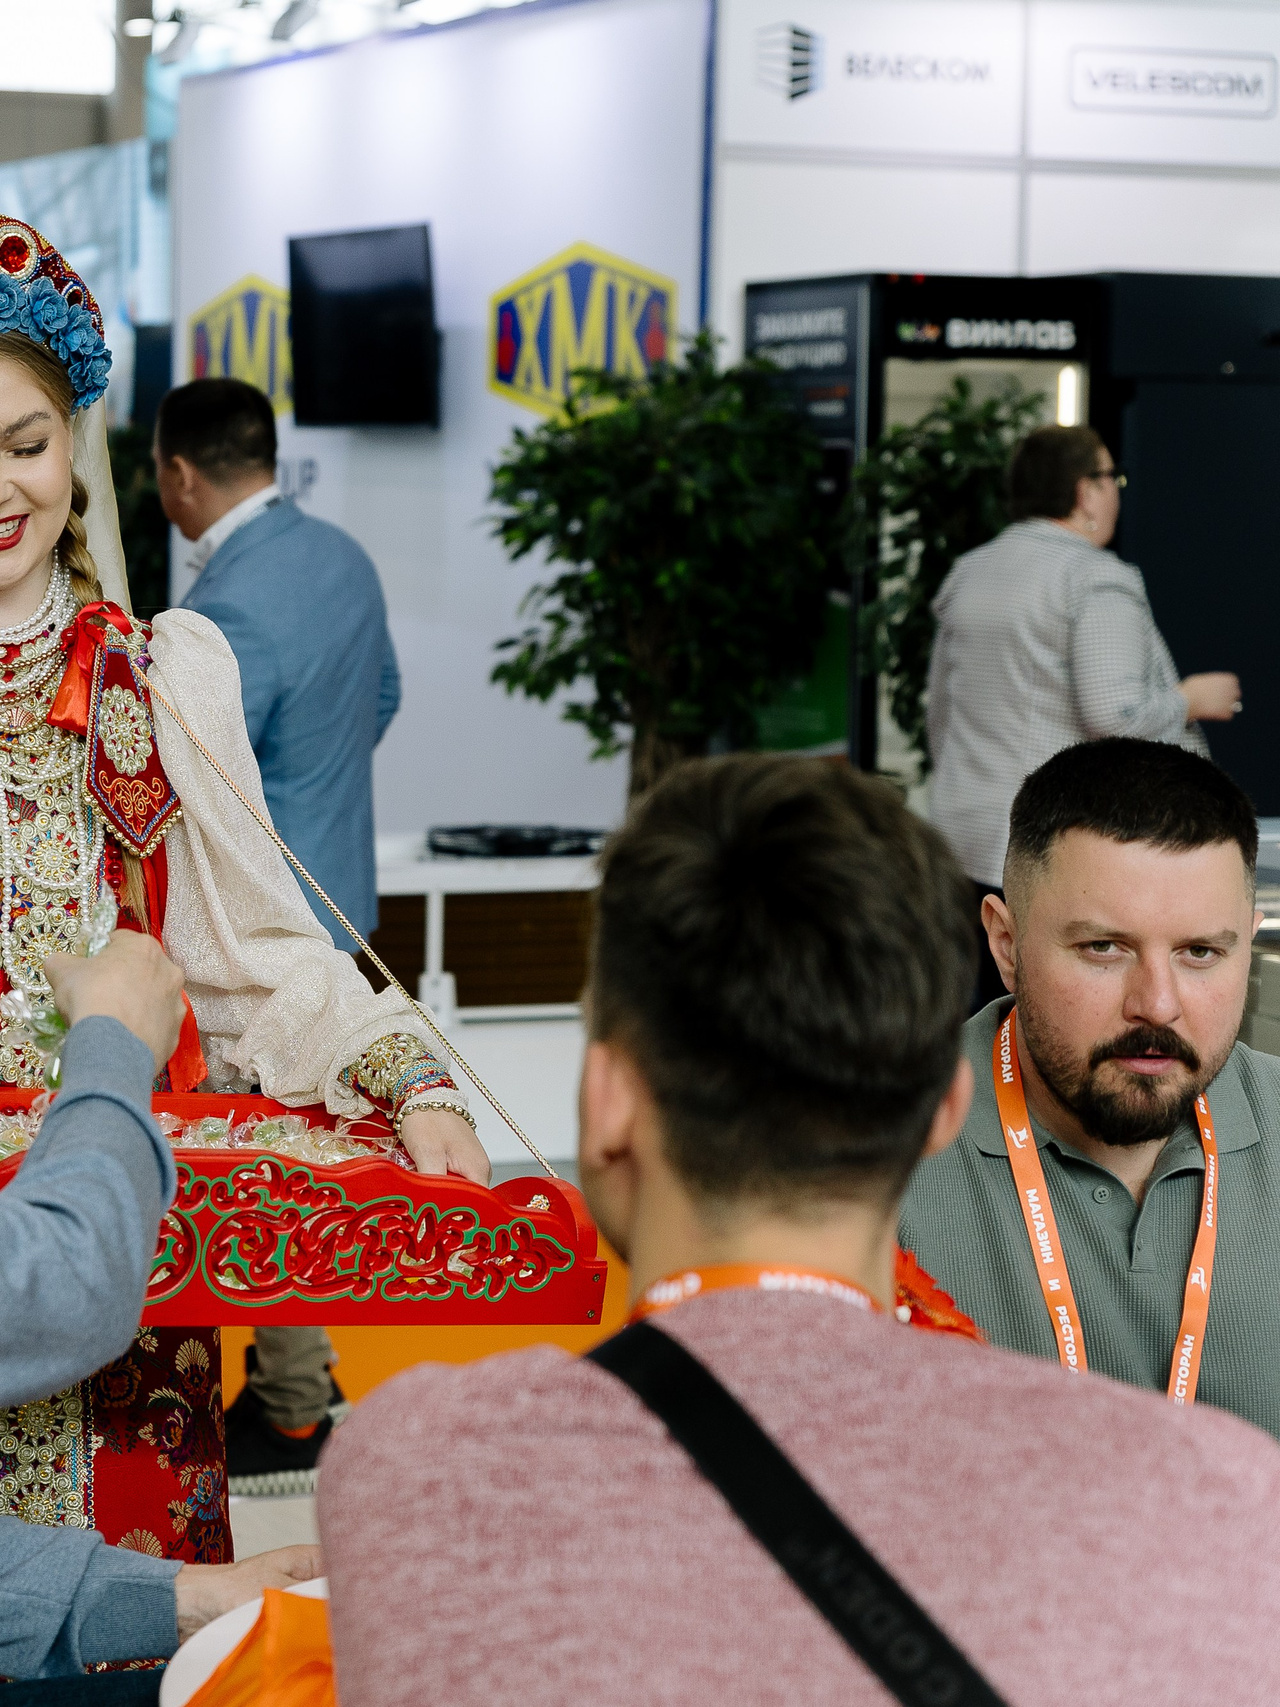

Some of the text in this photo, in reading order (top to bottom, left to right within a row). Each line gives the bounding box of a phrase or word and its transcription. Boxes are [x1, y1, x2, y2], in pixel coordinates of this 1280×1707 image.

[1001, 1018, 1014, 1084] РЕСТОРАН
[1204, 1128, 1215, 1228] МАГАЗИН И
[1026, 1188, 1080, 1376] МАГАЗИН И РЕСТОРА
[1174, 1333, 1195, 1405] ЕСТОРАН
